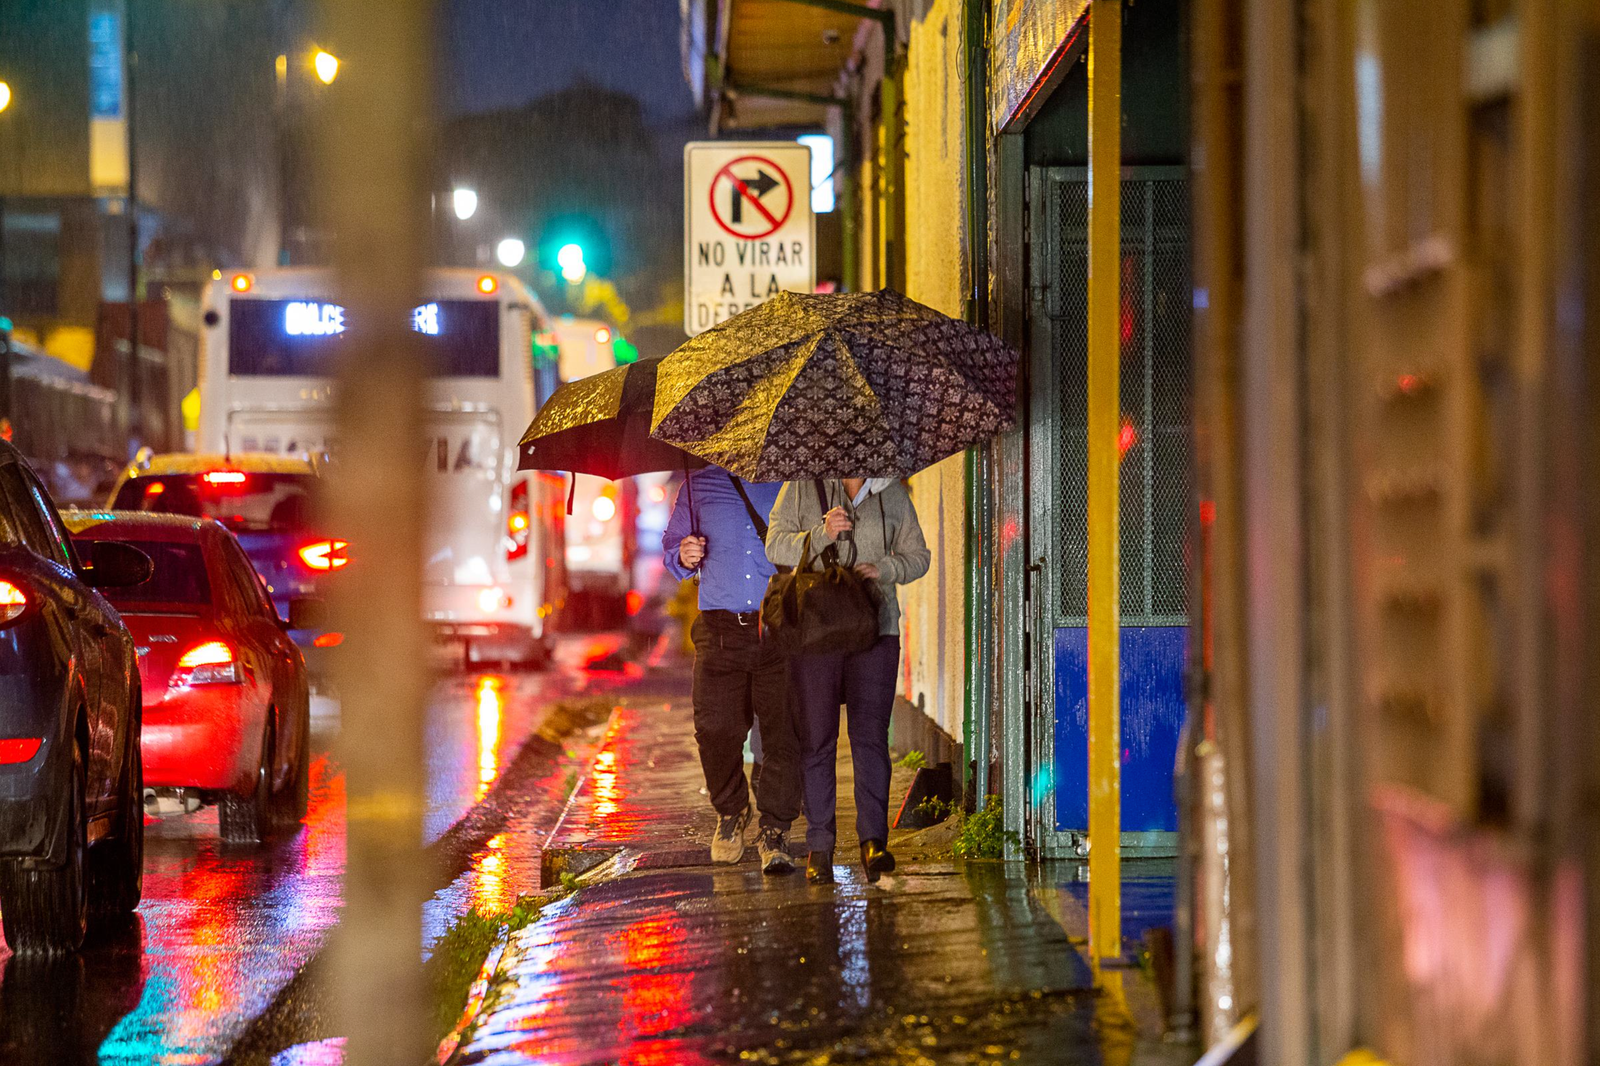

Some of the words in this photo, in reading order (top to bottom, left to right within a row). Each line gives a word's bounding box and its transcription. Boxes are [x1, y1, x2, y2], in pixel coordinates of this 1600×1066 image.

[699, 242, 725, 266] NO
[736, 242, 803, 266] VIRAR
[721, 273, 735, 297] A
[751, 273, 780, 298] LA
